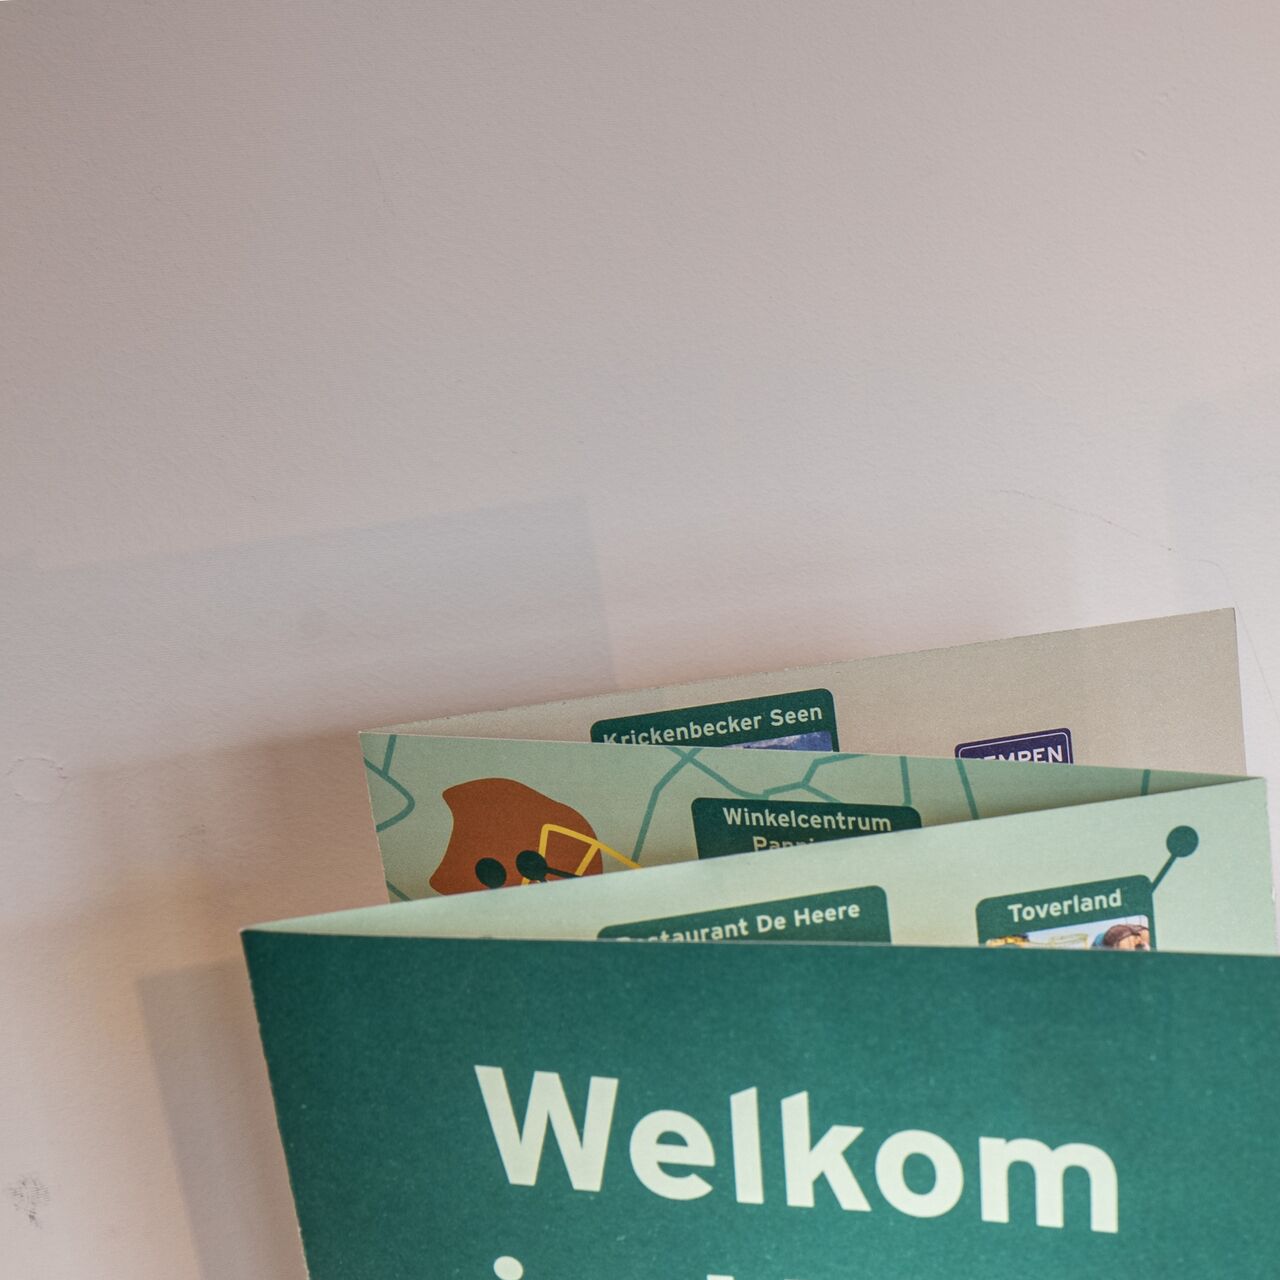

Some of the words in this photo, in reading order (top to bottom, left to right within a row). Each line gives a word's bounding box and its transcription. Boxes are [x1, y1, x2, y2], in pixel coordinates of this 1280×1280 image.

[603, 714, 762, 746] Krickenbecker
[770, 706, 823, 727] Seen
[722, 807, 892, 832] Winkelcentrum
[756, 914, 786, 933] De
[793, 904, 861, 927] Heere
[1008, 888, 1122, 923] Toverland
[476, 1066, 1118, 1233] Welkom
